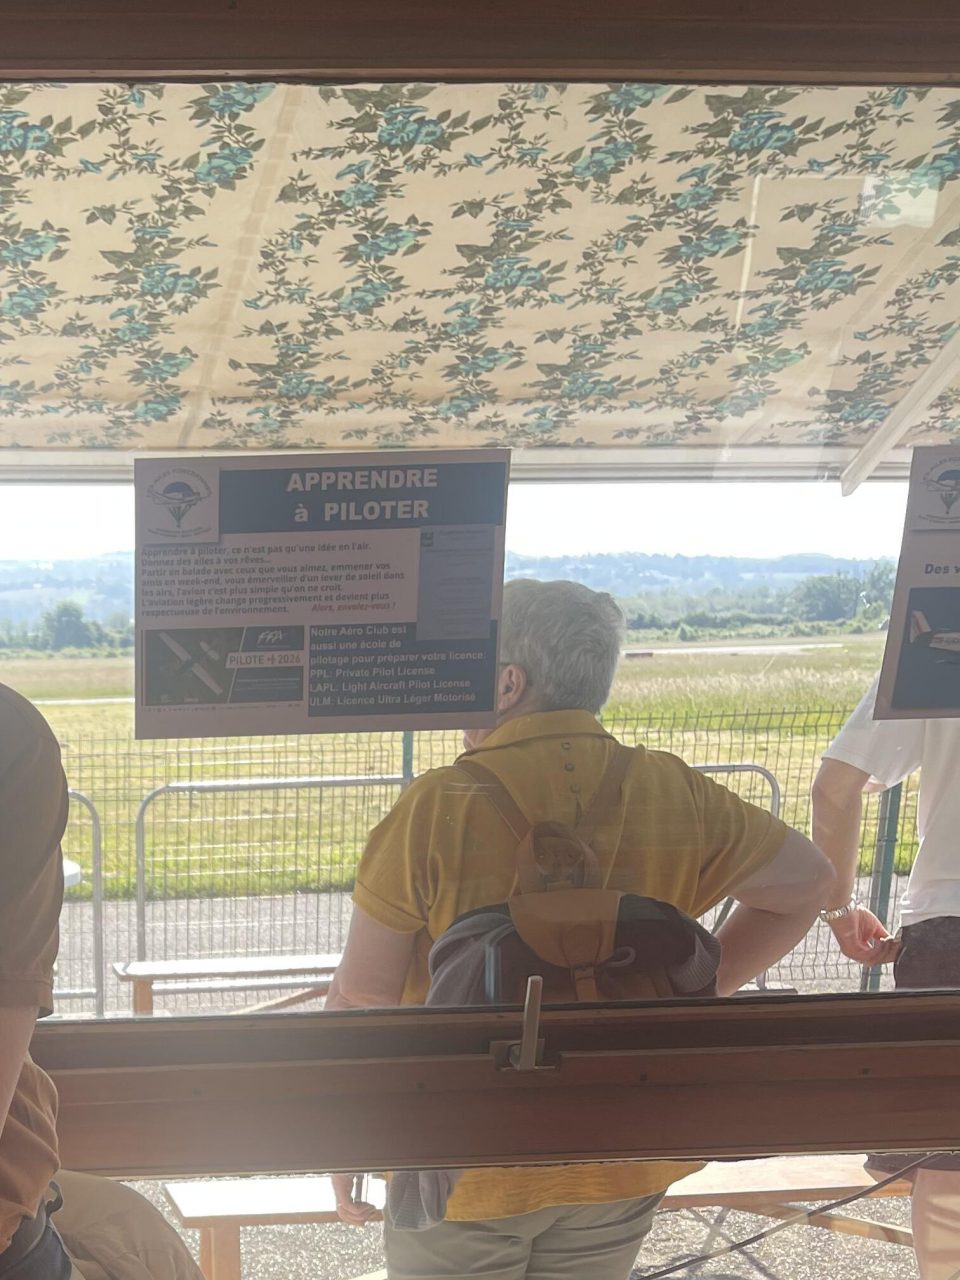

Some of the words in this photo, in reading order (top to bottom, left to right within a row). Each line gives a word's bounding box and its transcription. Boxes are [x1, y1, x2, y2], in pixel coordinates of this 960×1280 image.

[286, 468, 438, 492] APPRENDRE
[294, 503, 308, 522] à
[325, 500, 429, 521] PILOTER
[924, 563, 949, 574] Des
[229, 655, 264, 665] PILOTE
[277, 654, 301, 664] 2026
